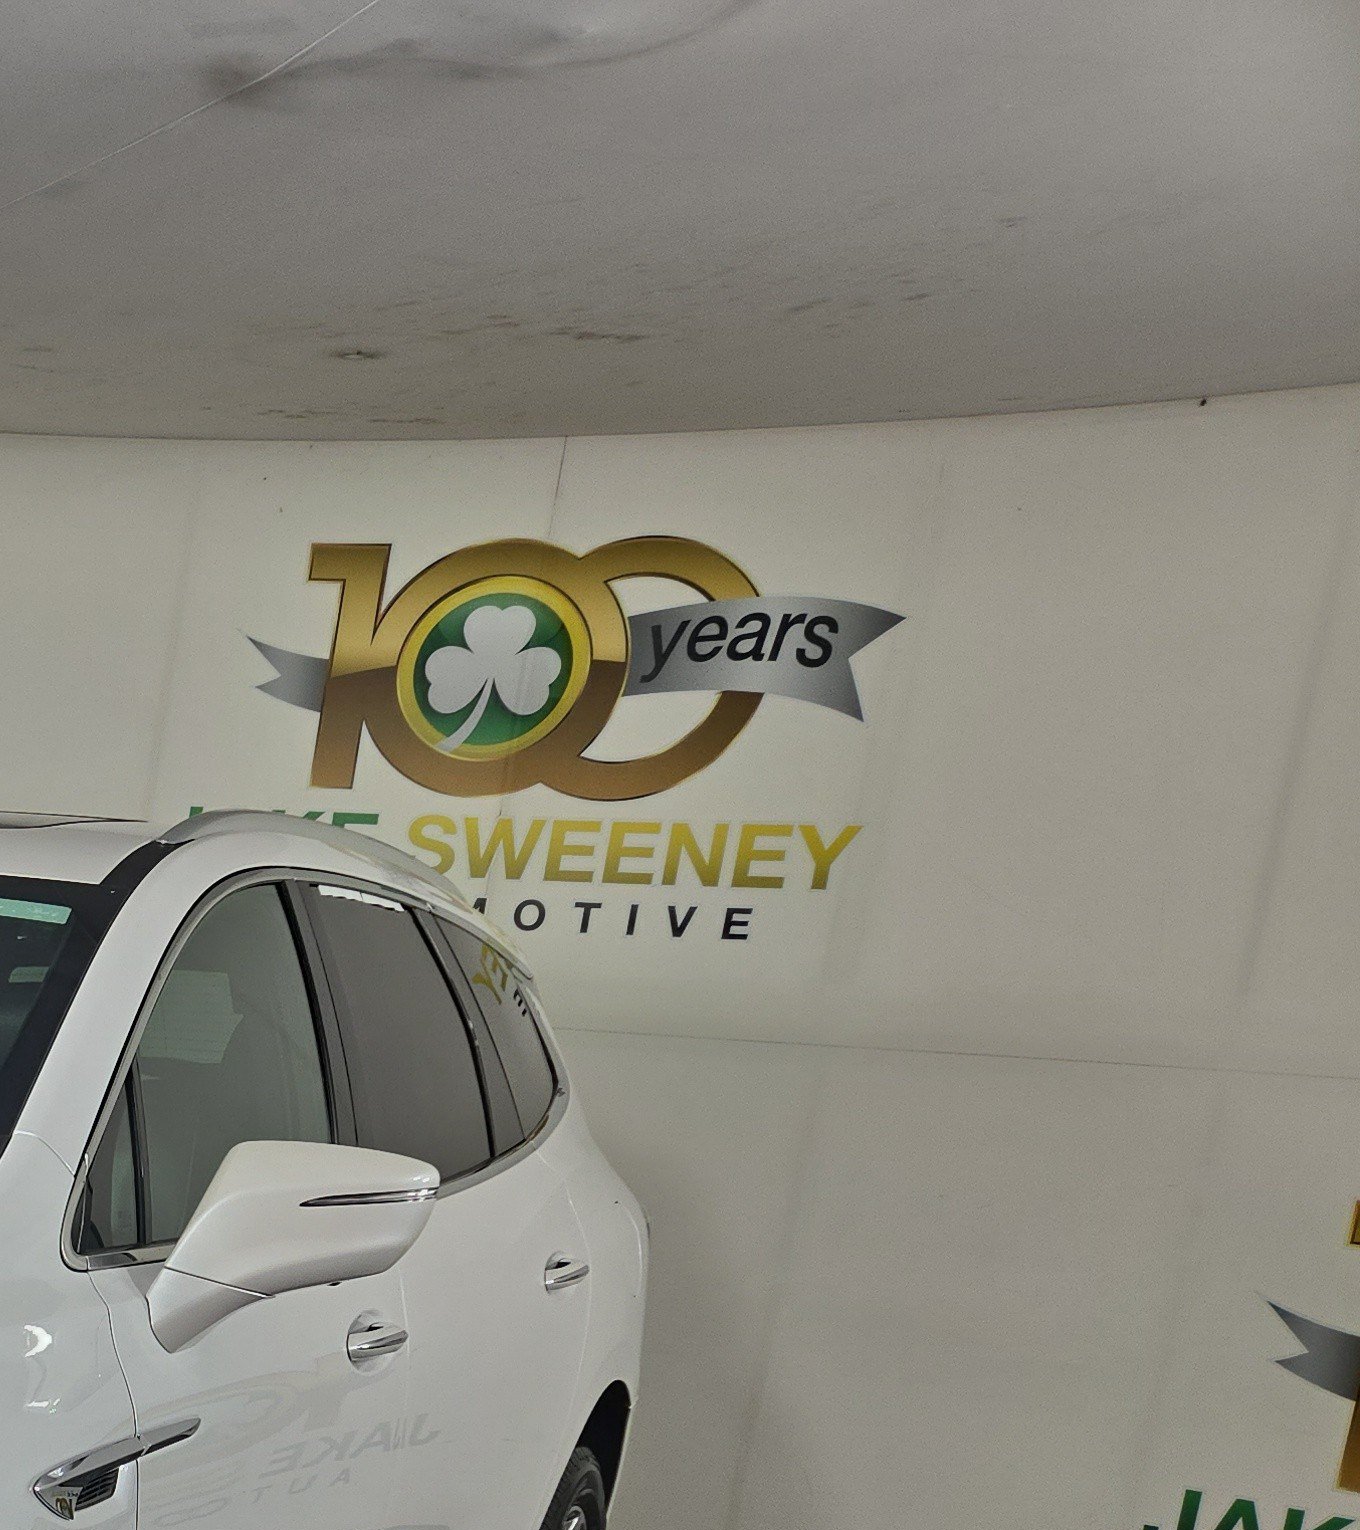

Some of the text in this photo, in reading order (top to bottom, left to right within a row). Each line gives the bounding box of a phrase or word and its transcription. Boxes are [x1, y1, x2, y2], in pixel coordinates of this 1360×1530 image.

[640, 611, 839, 683] years
[407, 812, 864, 891] SWEENEY
[473, 897, 755, 941] OTIVE
